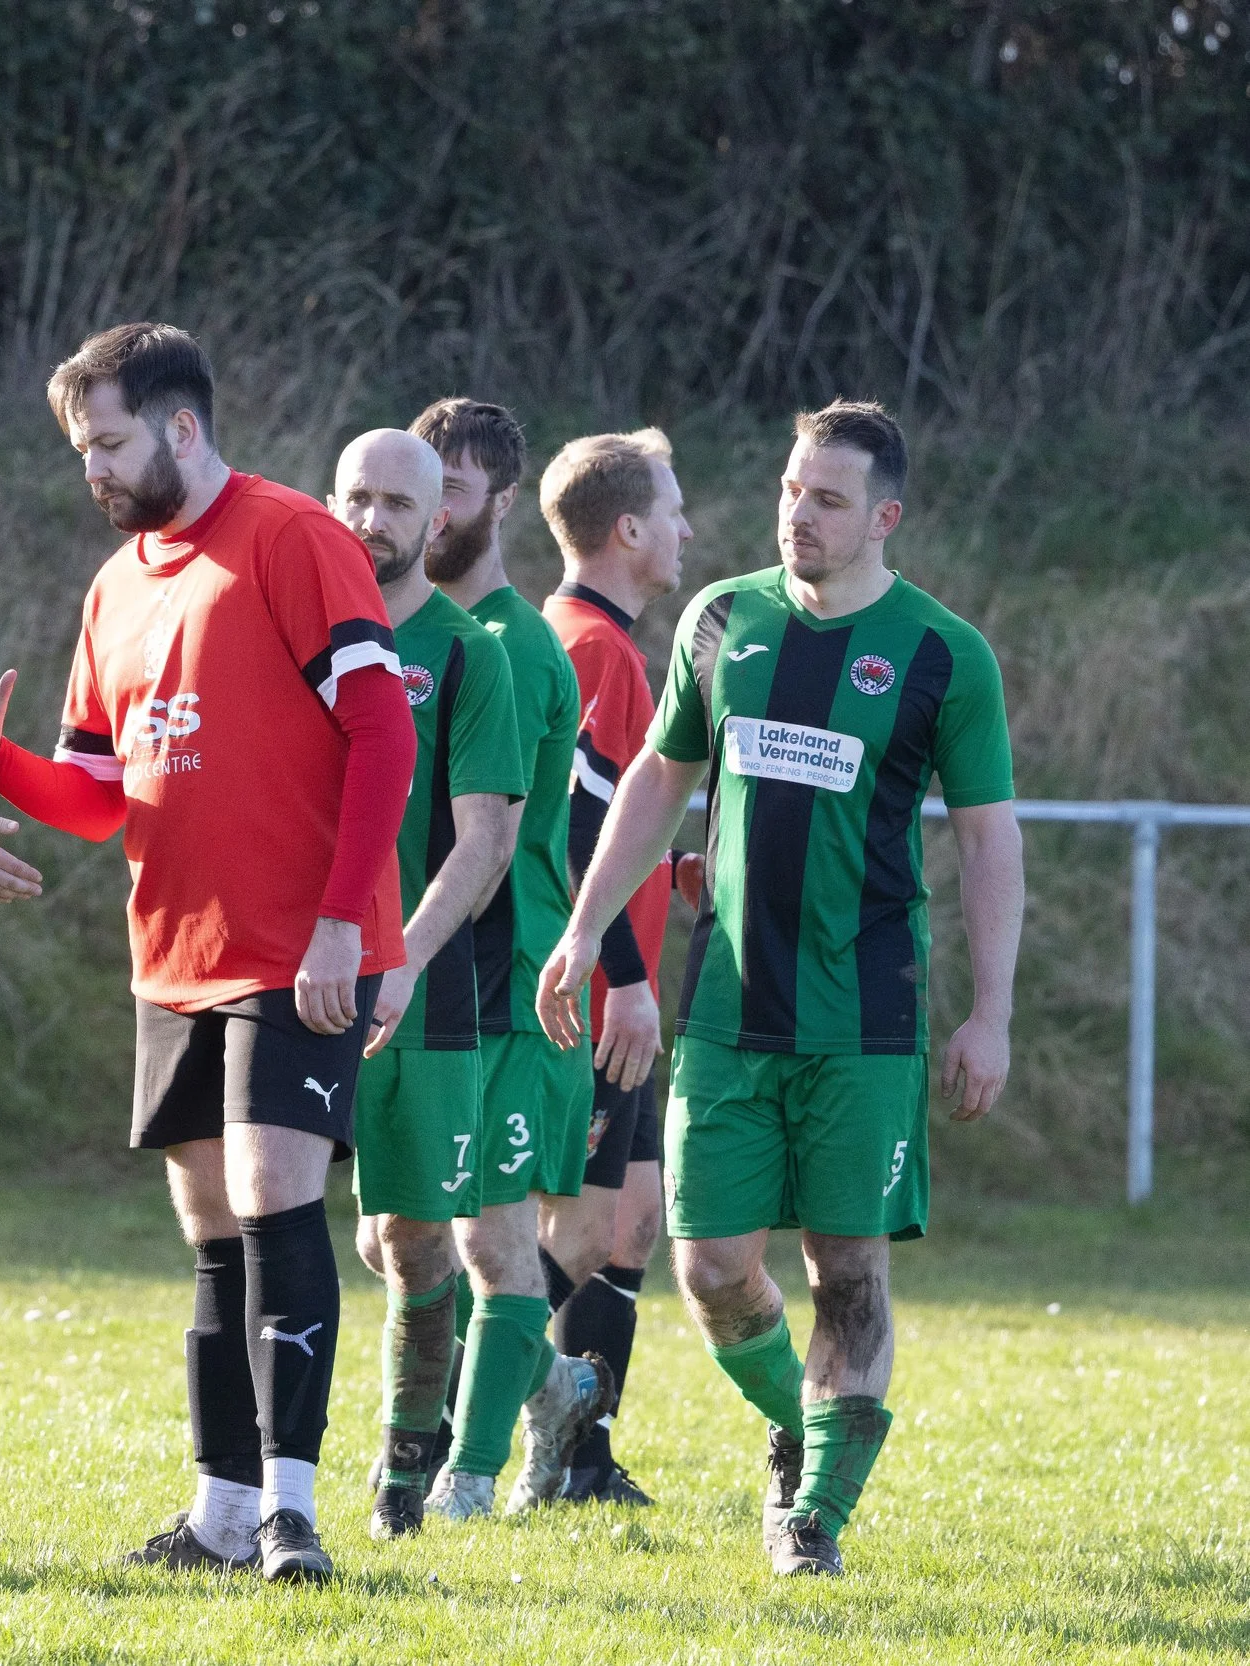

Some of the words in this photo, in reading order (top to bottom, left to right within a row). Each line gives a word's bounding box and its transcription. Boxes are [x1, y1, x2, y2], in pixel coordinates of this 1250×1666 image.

[758, 724, 842, 753] Lakeland
[758, 742, 855, 774] Verandahs
[765, 764, 801, 777] FENCING
[807, 770, 851, 788] PERGOLAS
[506, 1113, 530, 1147] 3
[453, 1134, 471, 1168] 7
[891, 1140, 908, 1174] 5
